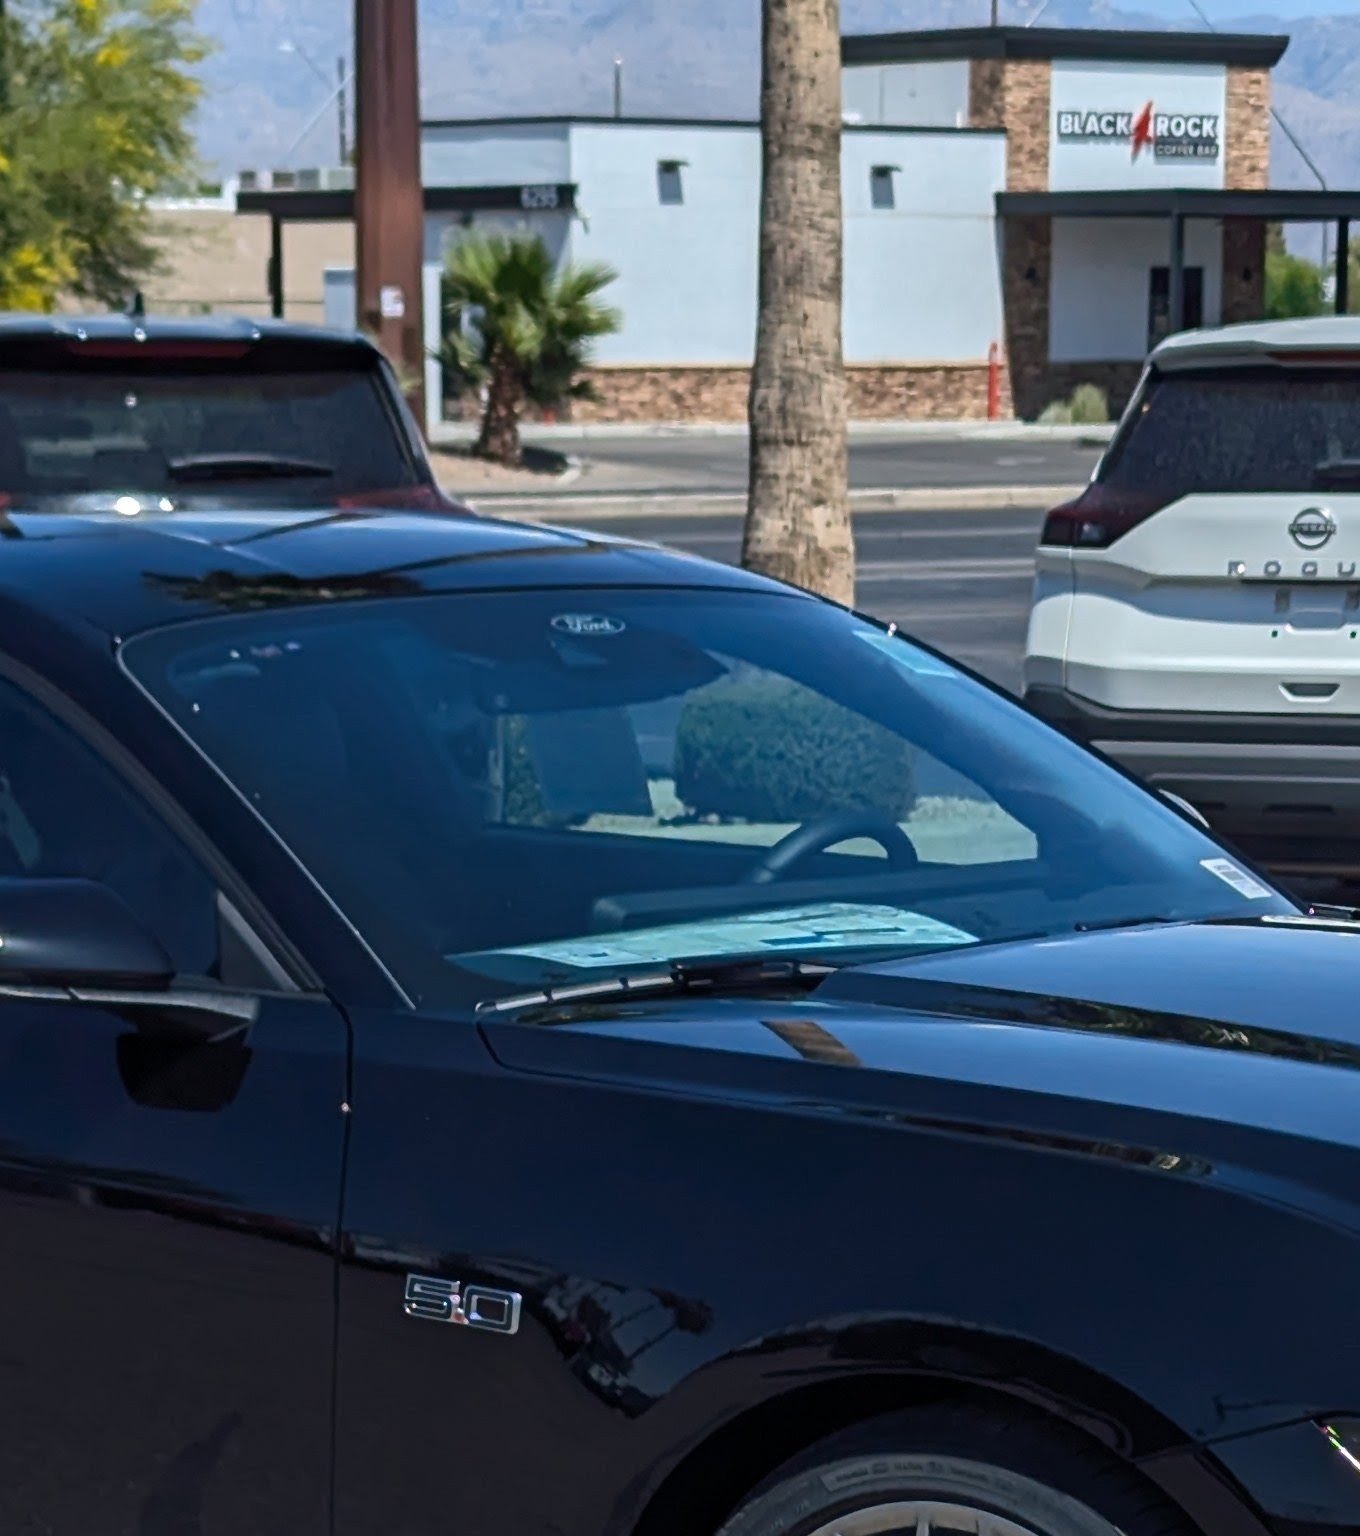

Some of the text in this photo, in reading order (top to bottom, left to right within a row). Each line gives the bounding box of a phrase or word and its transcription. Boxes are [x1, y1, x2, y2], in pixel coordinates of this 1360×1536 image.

[1058, 112, 1219, 138] BLACK ROCK
[404, 1273, 522, 1335] 5.0
